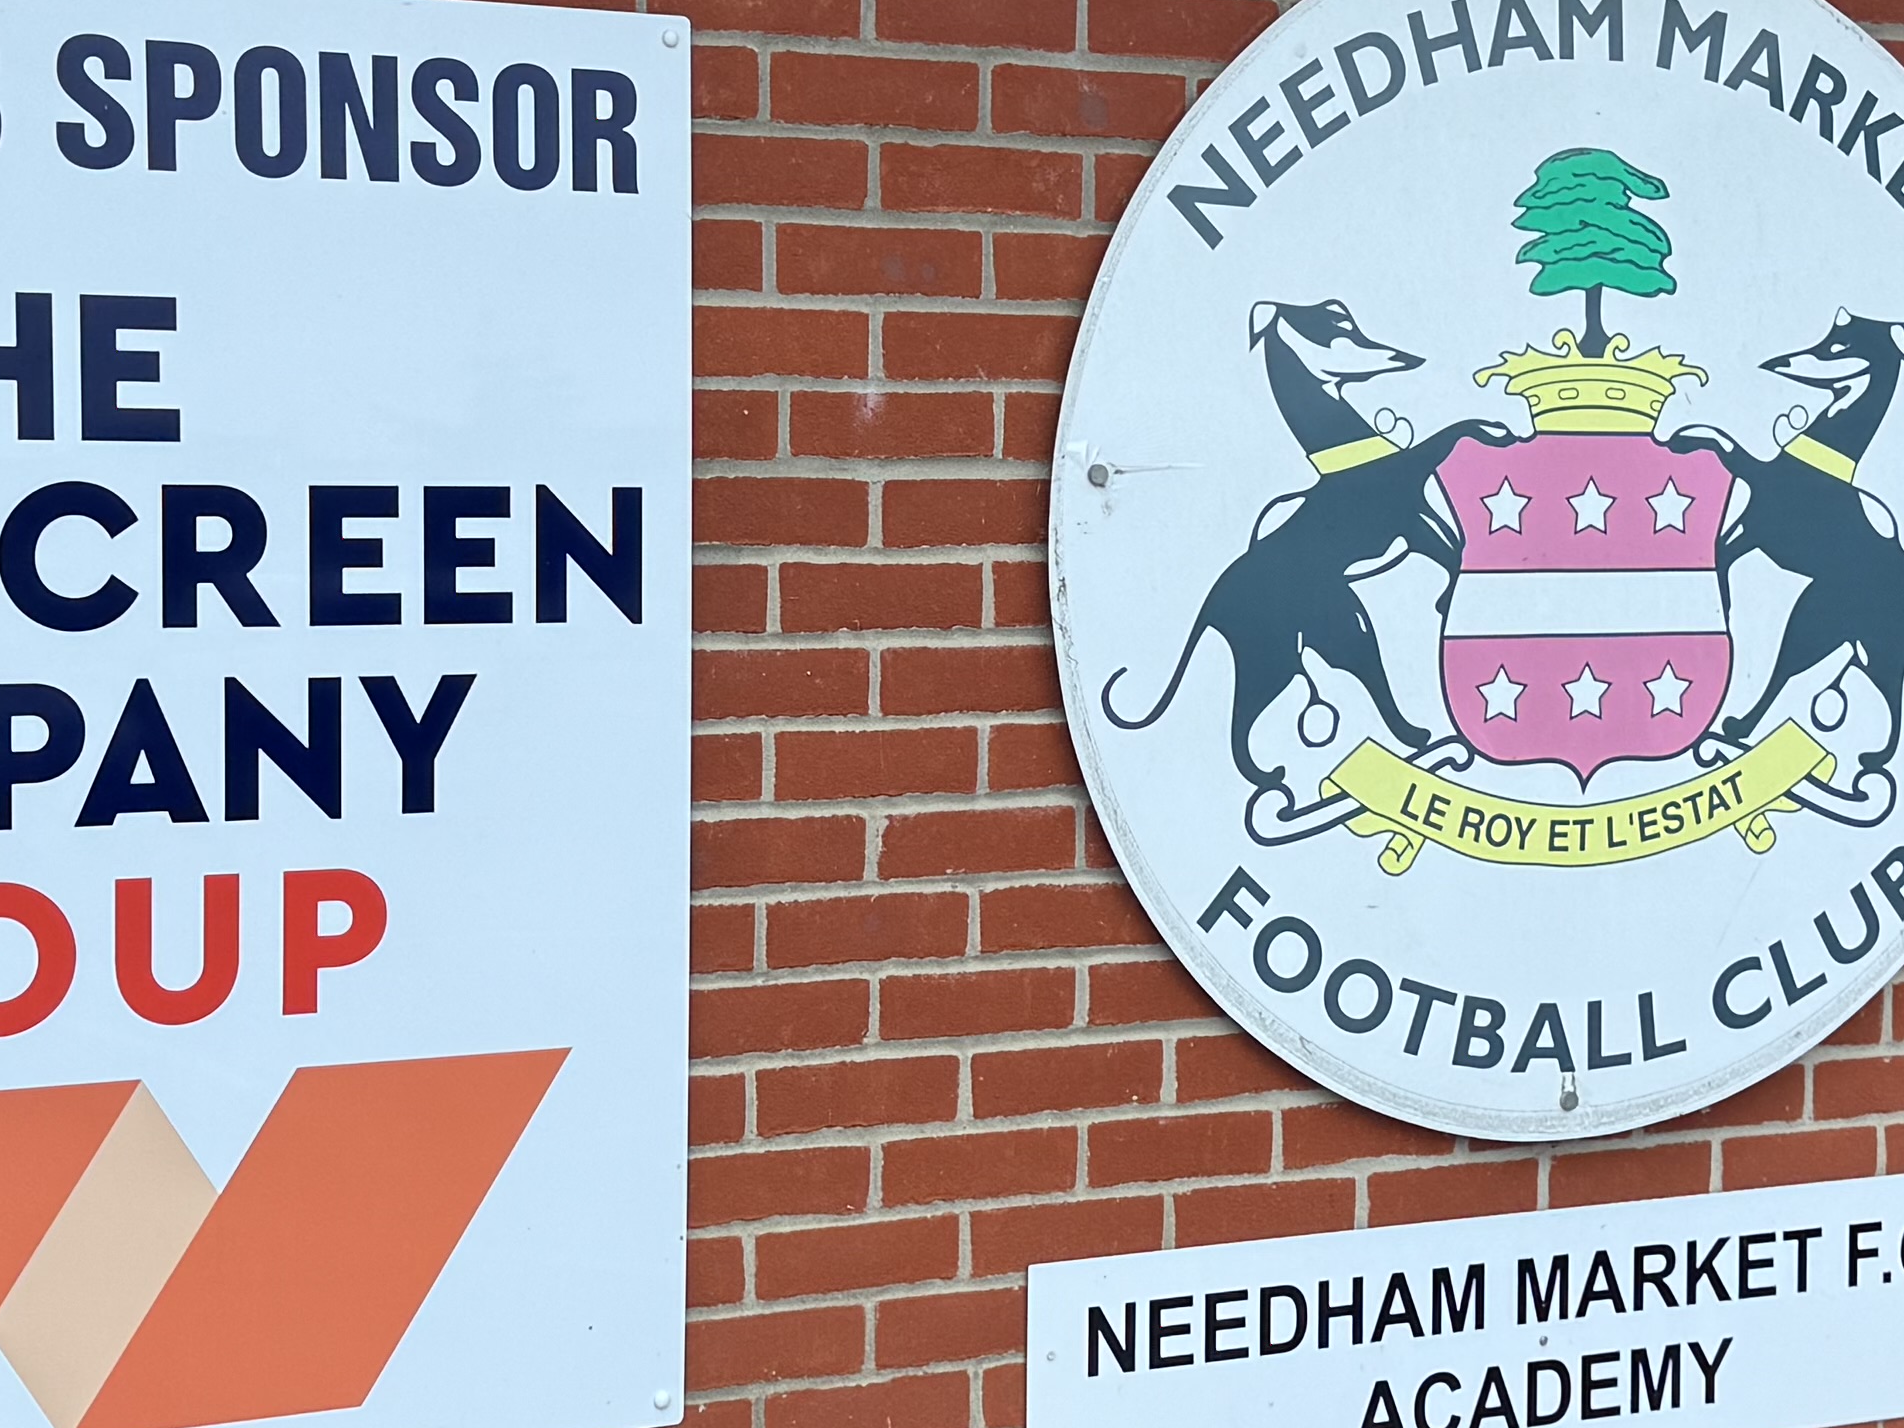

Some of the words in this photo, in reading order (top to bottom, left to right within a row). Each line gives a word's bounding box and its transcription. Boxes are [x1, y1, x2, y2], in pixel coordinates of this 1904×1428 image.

[56, 34, 639, 194] SPONSOR
[1400, 783, 1451, 831] LE
[1458, 806, 1537, 851] ROY
[1548, 818, 1594, 852] ET
[1607, 770, 1743, 848] L'ESTAT
[1197, 865, 1687, 1073] FOOTBALL
[1087, 1262, 1487, 1377] NEEDHAM
[1516, 1227, 1823, 1323] MARKET
